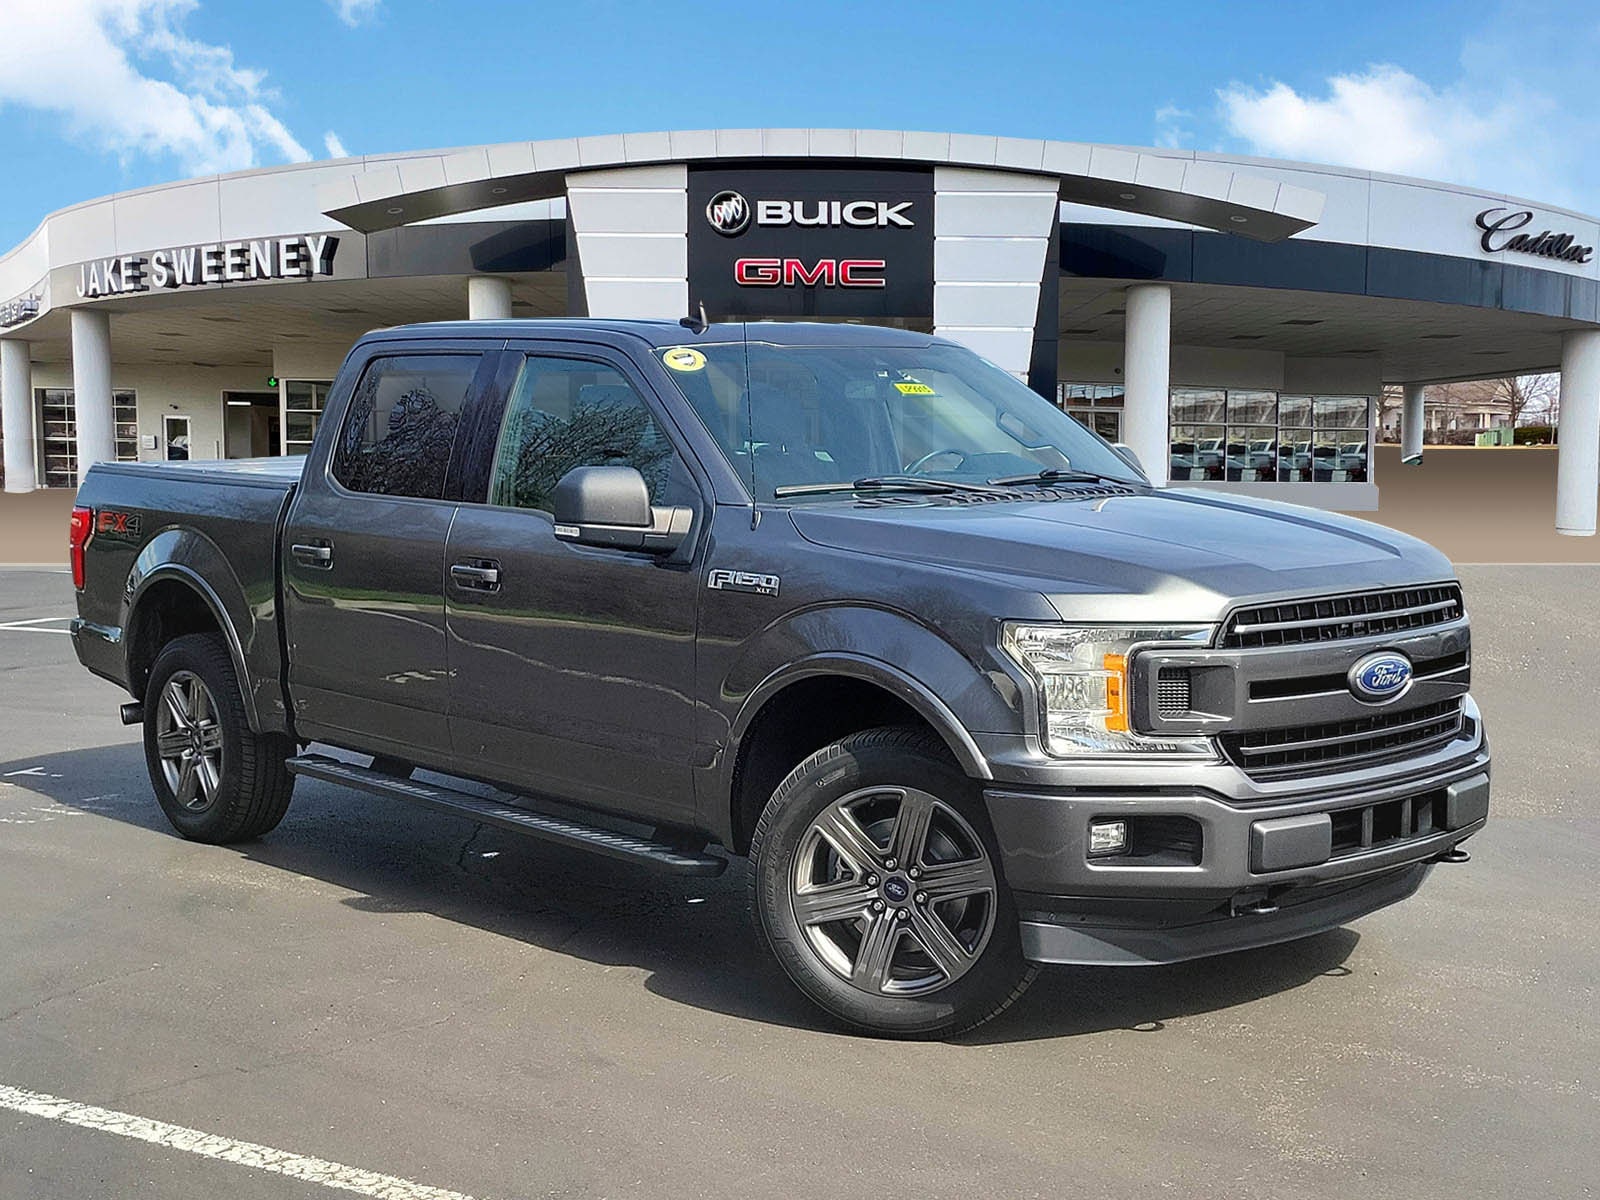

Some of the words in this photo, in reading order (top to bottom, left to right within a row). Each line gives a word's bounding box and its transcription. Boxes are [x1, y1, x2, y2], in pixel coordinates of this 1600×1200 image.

[757, 200, 915, 226] BUICK
[1475, 207, 1593, 264] Cadillac
[76, 256, 142, 298] JAKE
[151, 235, 334, 289] SWEENEY
[734, 258, 886, 287] GMC
[98, 511, 143, 537] FX4
[755, 586, 772, 594] XLT
[1371, 664, 1404, 688] Ford
